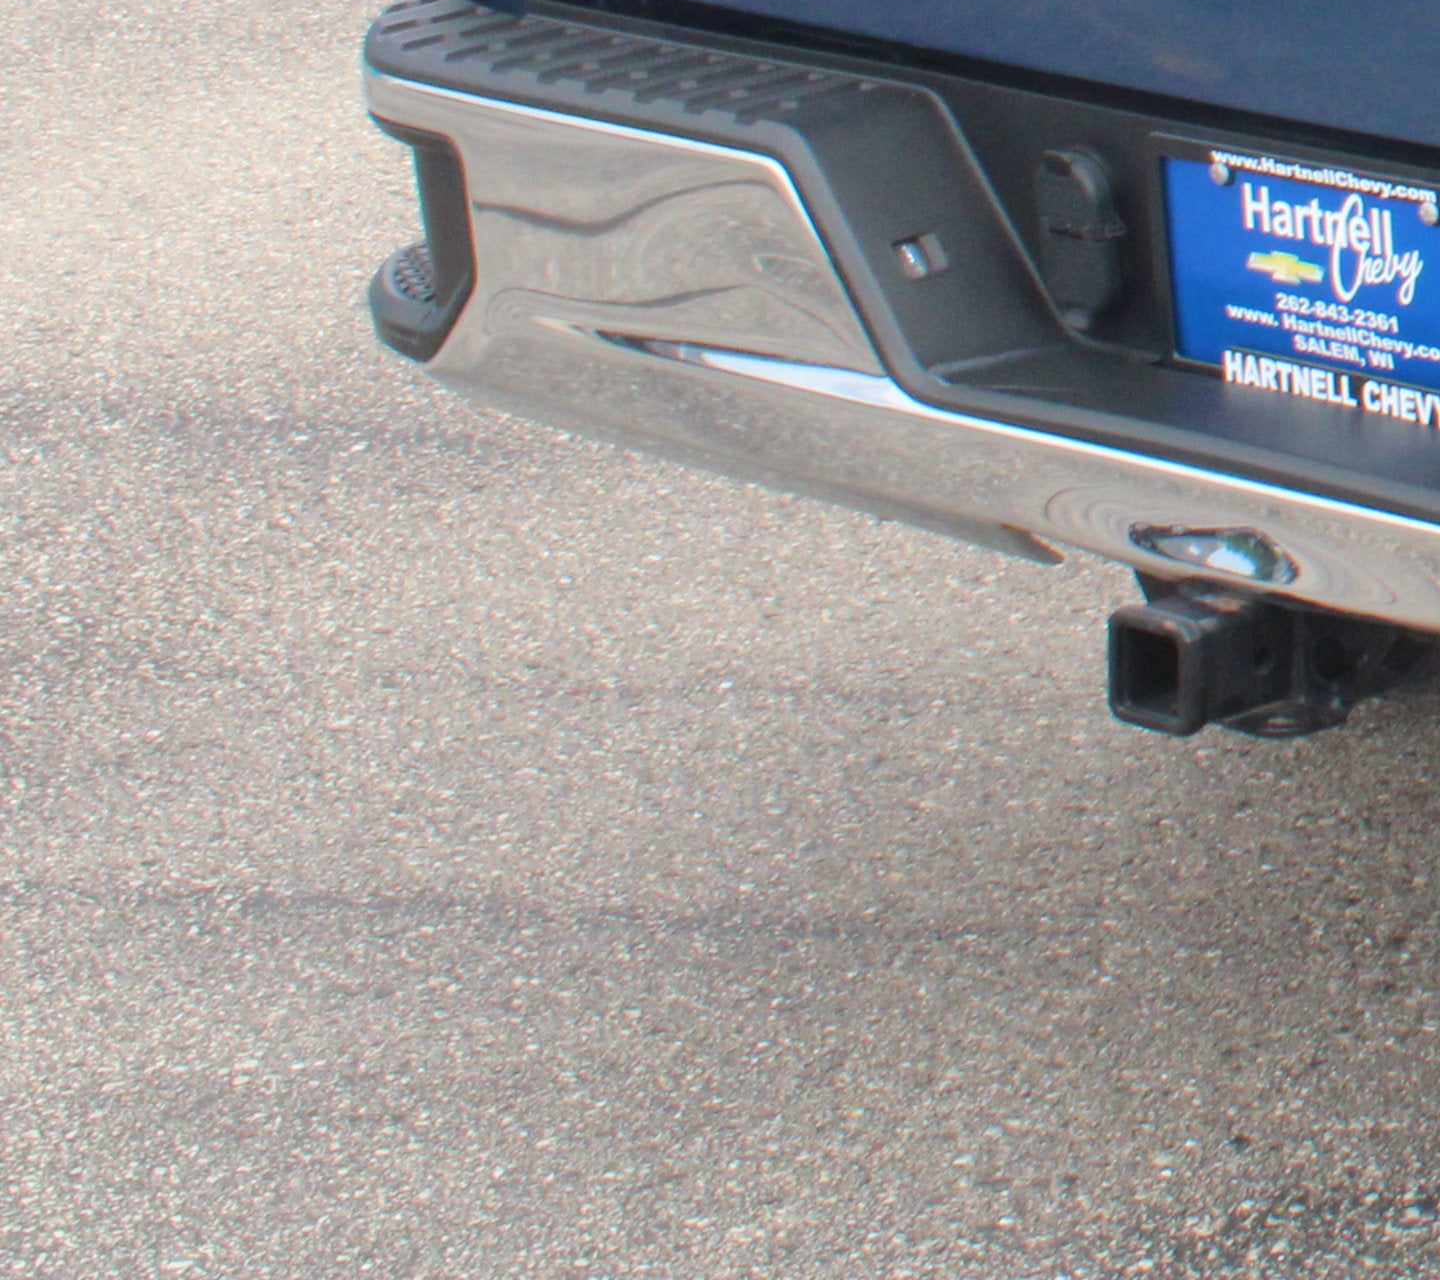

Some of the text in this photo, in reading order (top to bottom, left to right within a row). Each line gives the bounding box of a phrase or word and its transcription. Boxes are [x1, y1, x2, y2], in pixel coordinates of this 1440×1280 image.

[1211, 149, 1438, 204] www.HartnellChevy.com
[1242, 182, 1395, 258] Hartnell
[1330, 193, 1425, 306] Chevy
[1275, 291, 1400, 334] 262-843-2361
[1222, 348, 1358, 408] HARTNELL
[1292, 333, 1395, 371] SALEM, WI
